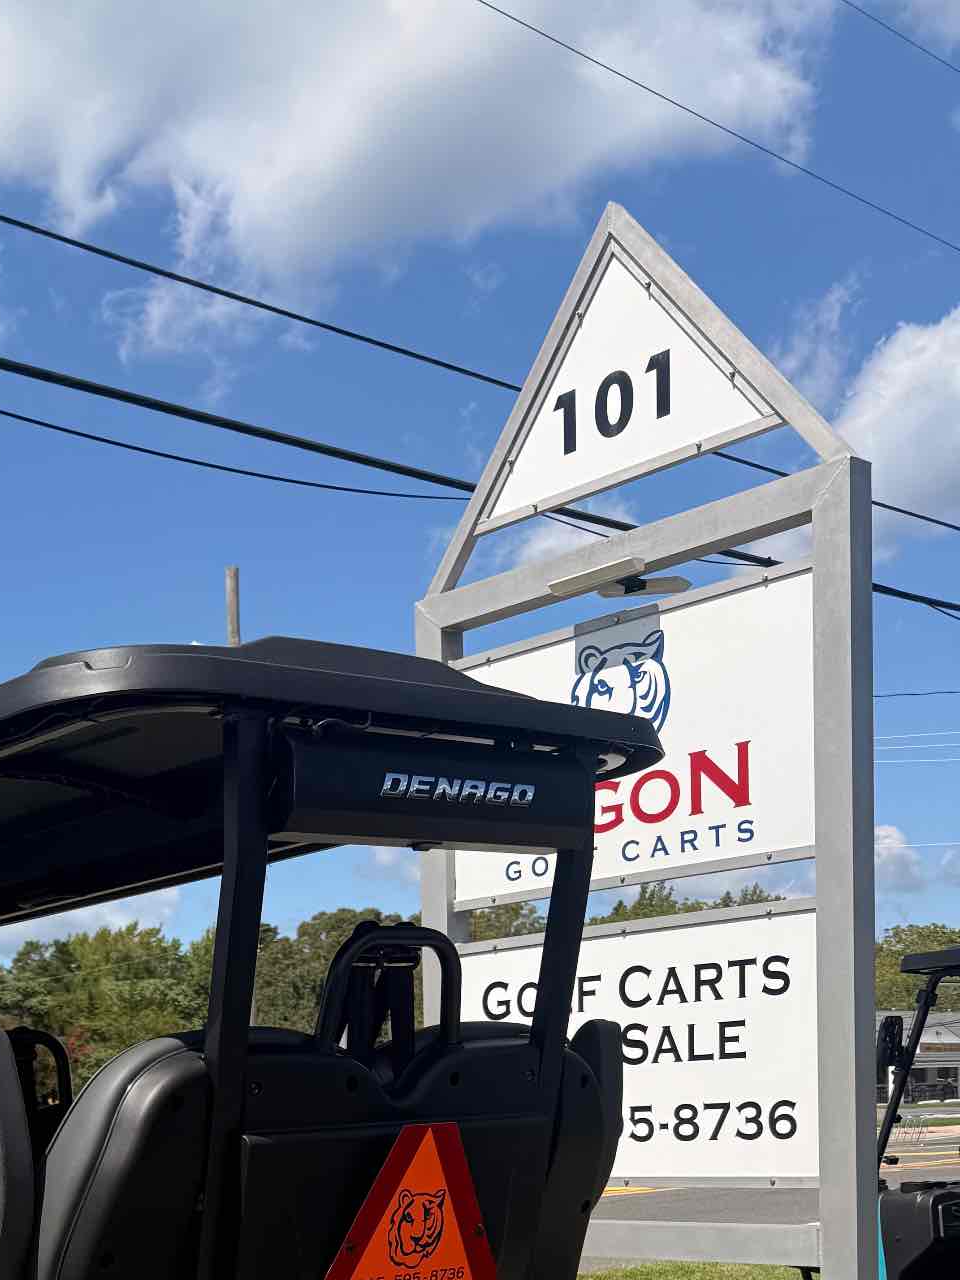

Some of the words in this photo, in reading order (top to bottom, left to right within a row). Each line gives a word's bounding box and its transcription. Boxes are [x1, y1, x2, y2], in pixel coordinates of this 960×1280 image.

[553, 349, 671, 456] 101
[381, 772, 536, 806] DENAGO
[593, 740, 752, 834] GON
[621, 820, 755, 861] CARTS
[482, 973, 601, 1021] GOF
[618, 955, 790, 1009] CARTS
[621, 1019, 747, 1065] SALE
[629, 1100, 797, 1142] 5-8736
